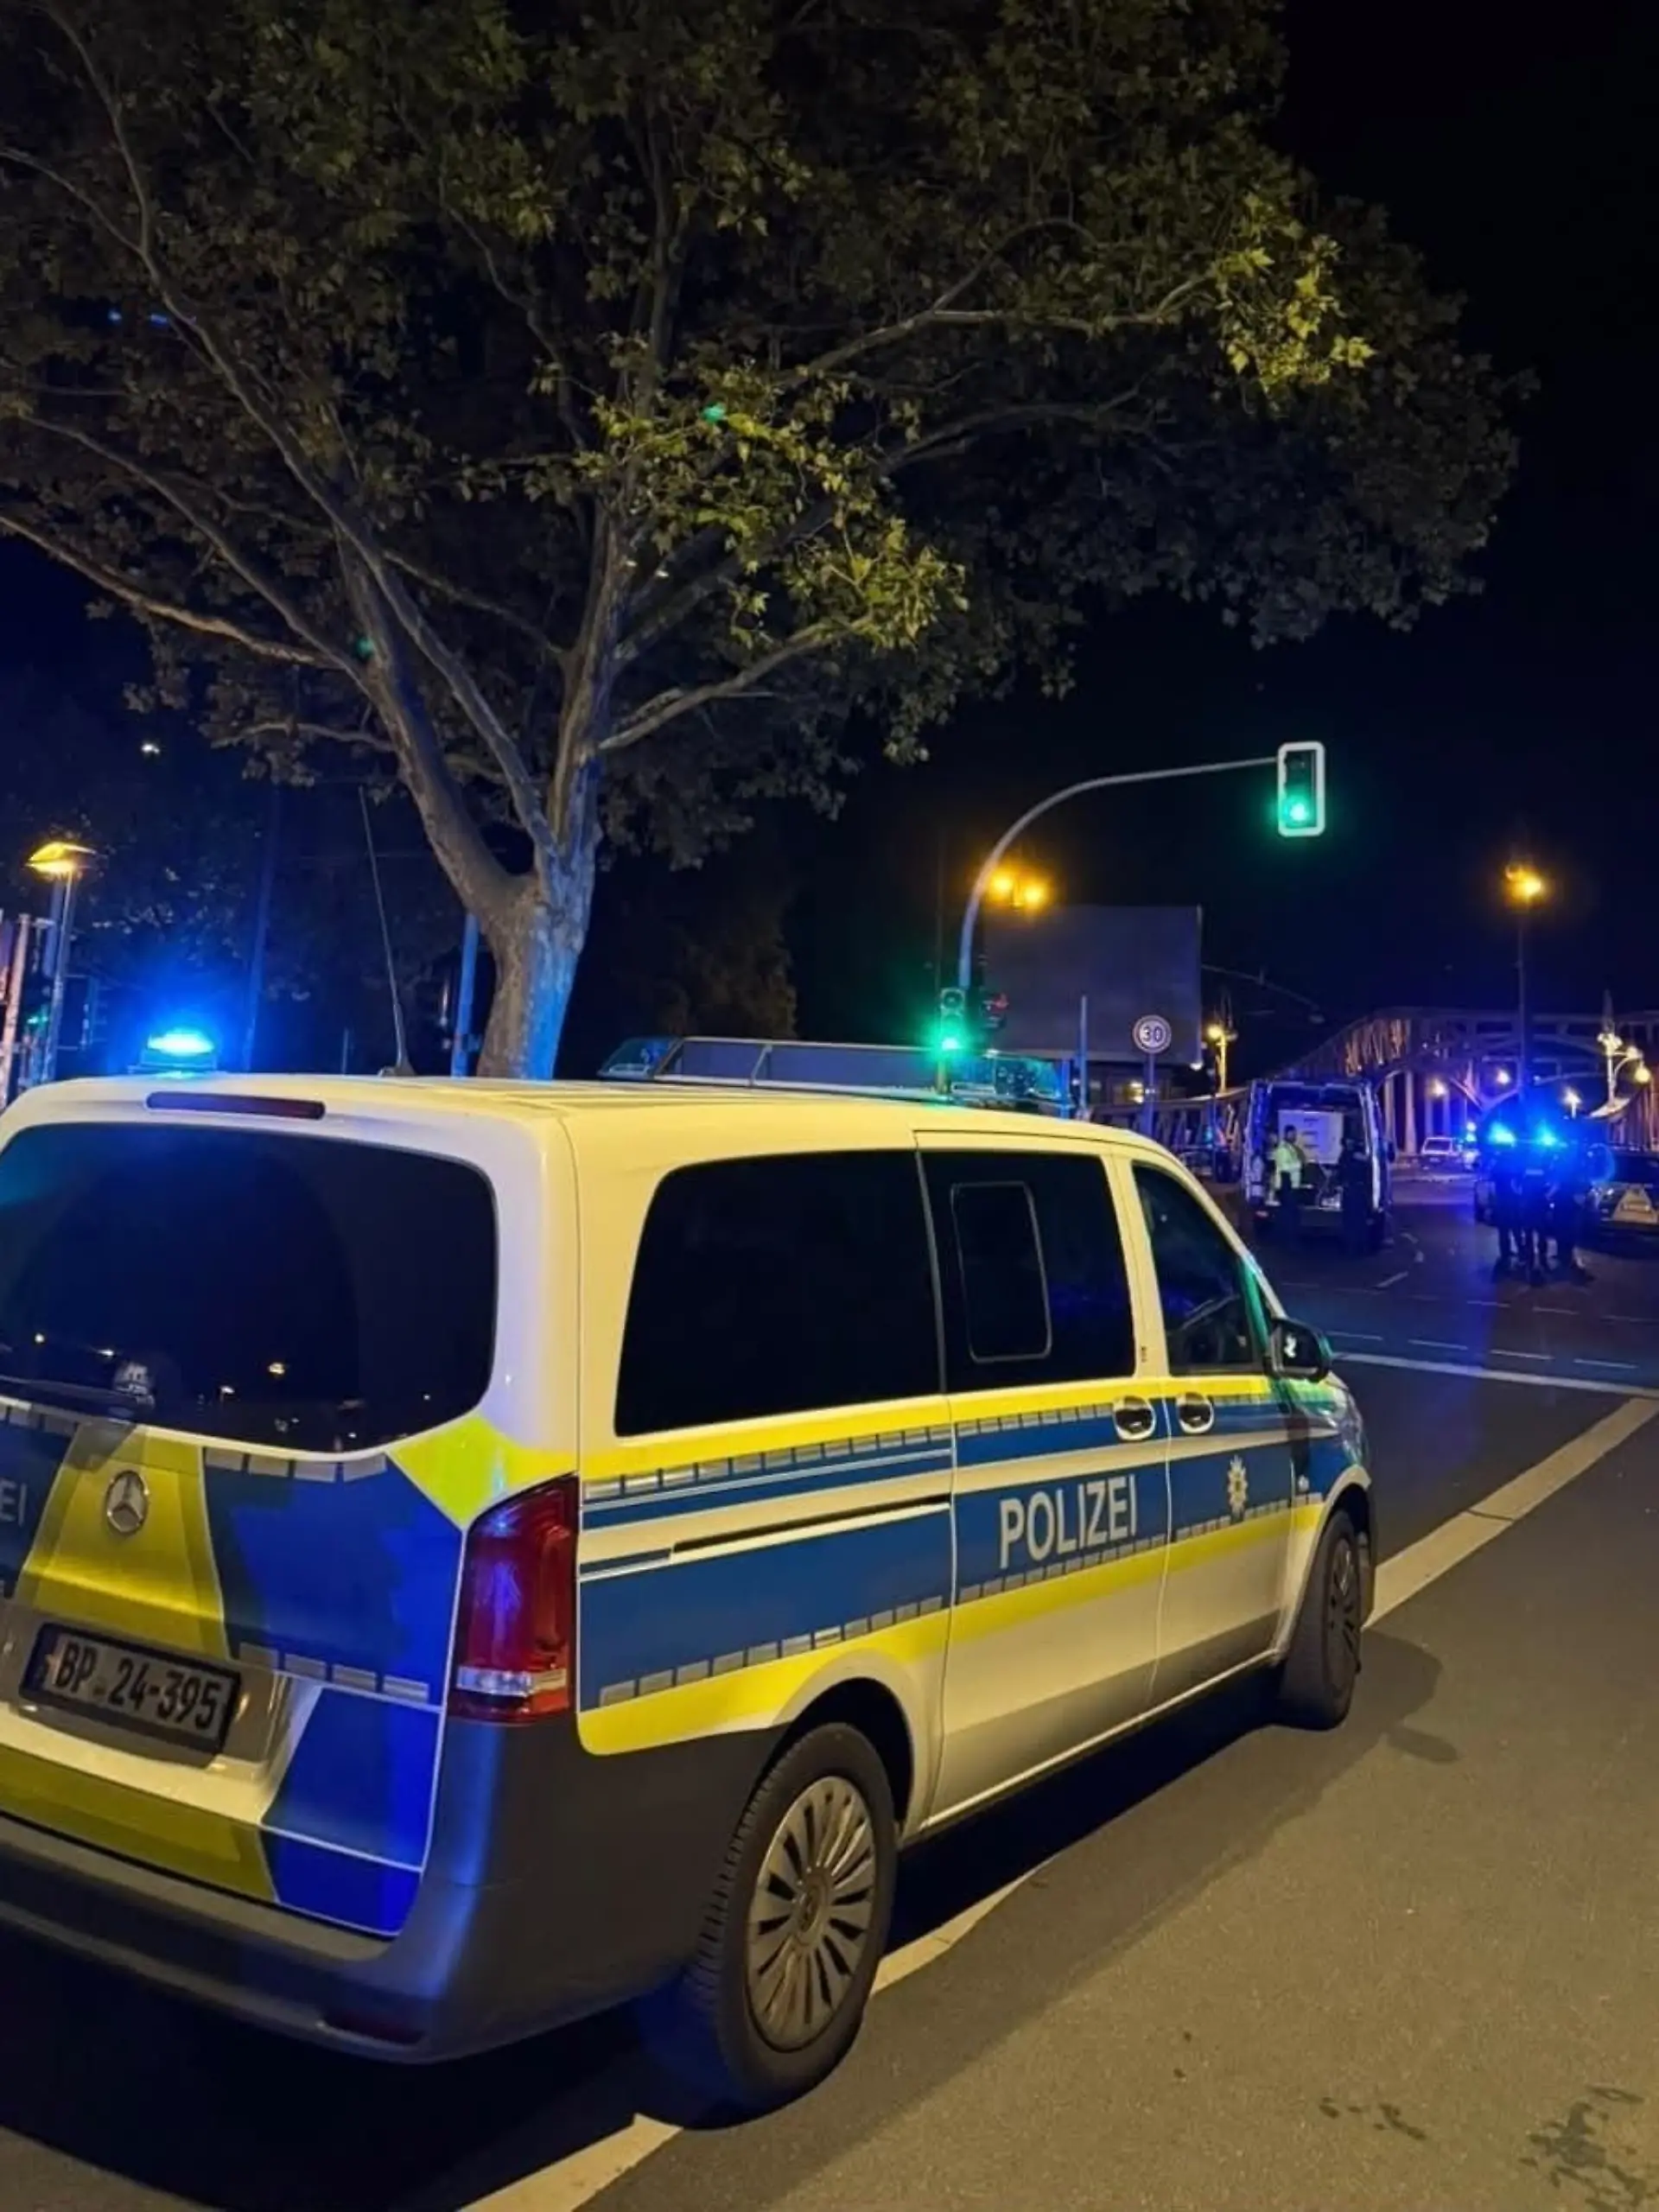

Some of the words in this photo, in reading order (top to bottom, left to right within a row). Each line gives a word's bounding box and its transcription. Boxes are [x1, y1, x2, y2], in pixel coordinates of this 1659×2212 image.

[1142, 1026, 1163, 1042] 30
[999, 1473, 1137, 1569] POLIZEI
[54, 1641, 98, 1694] BP
[108, 1657, 221, 1730] 24-395
